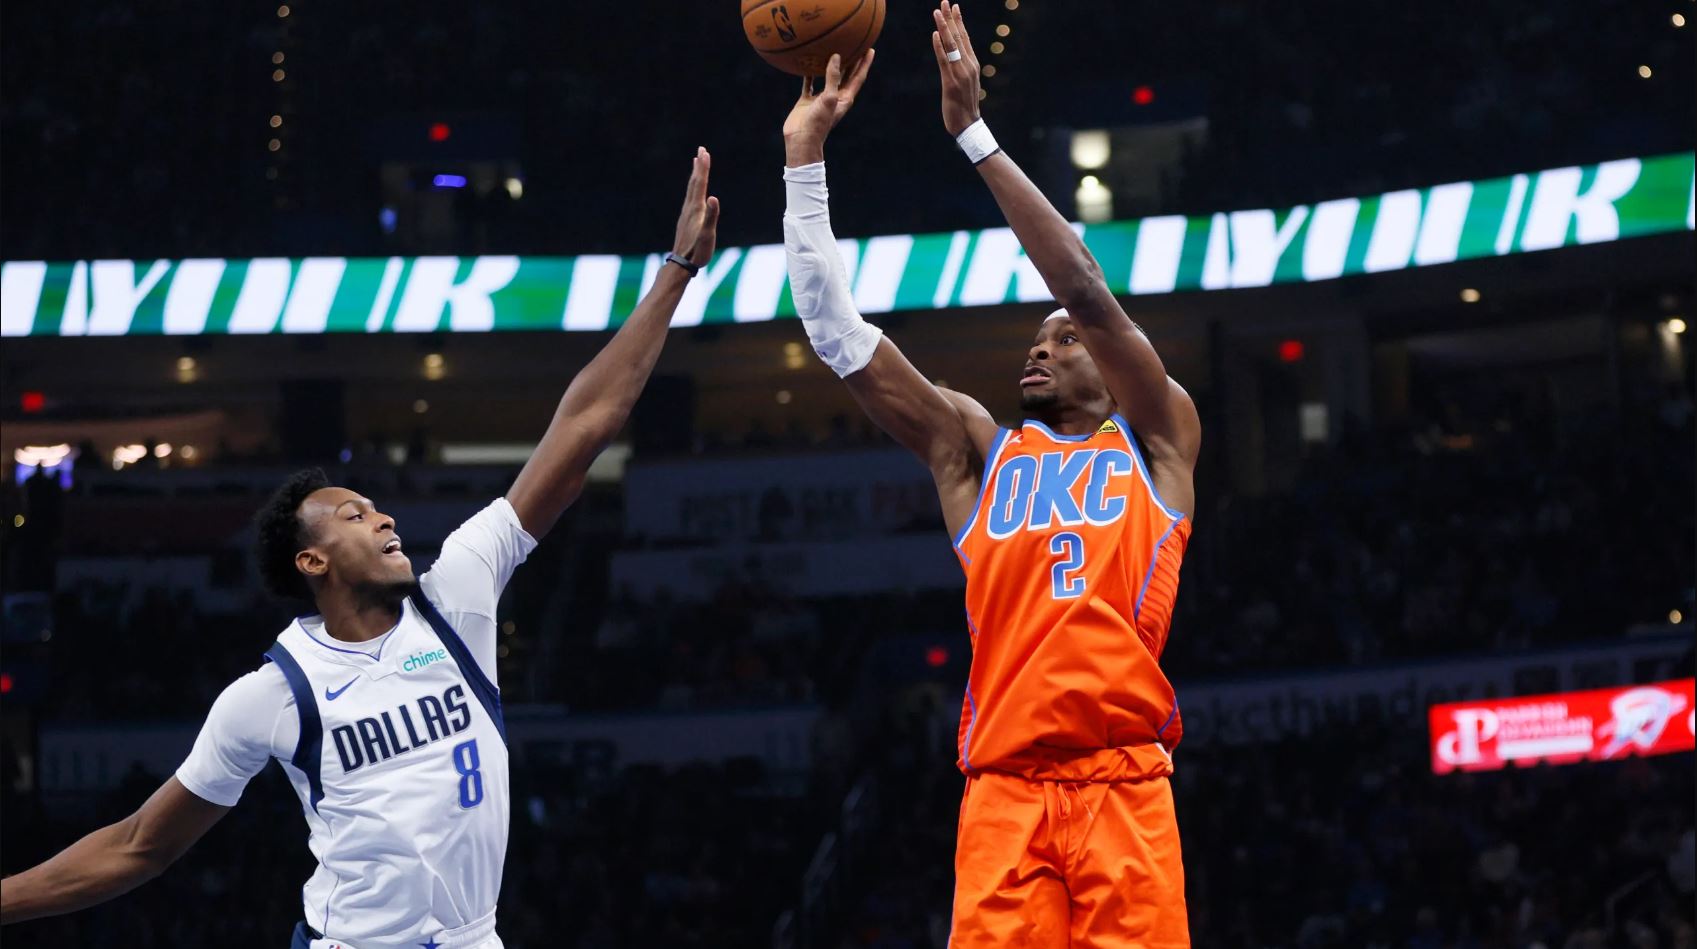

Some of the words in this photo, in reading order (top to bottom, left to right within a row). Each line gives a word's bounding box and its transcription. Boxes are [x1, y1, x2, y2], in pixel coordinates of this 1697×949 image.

[986, 448, 1133, 540] OKC
[1050, 531, 1086, 600] 2
[403, 648, 447, 672] chime
[332, 684, 472, 775] DALLAS
[452, 738, 484, 810] 8
